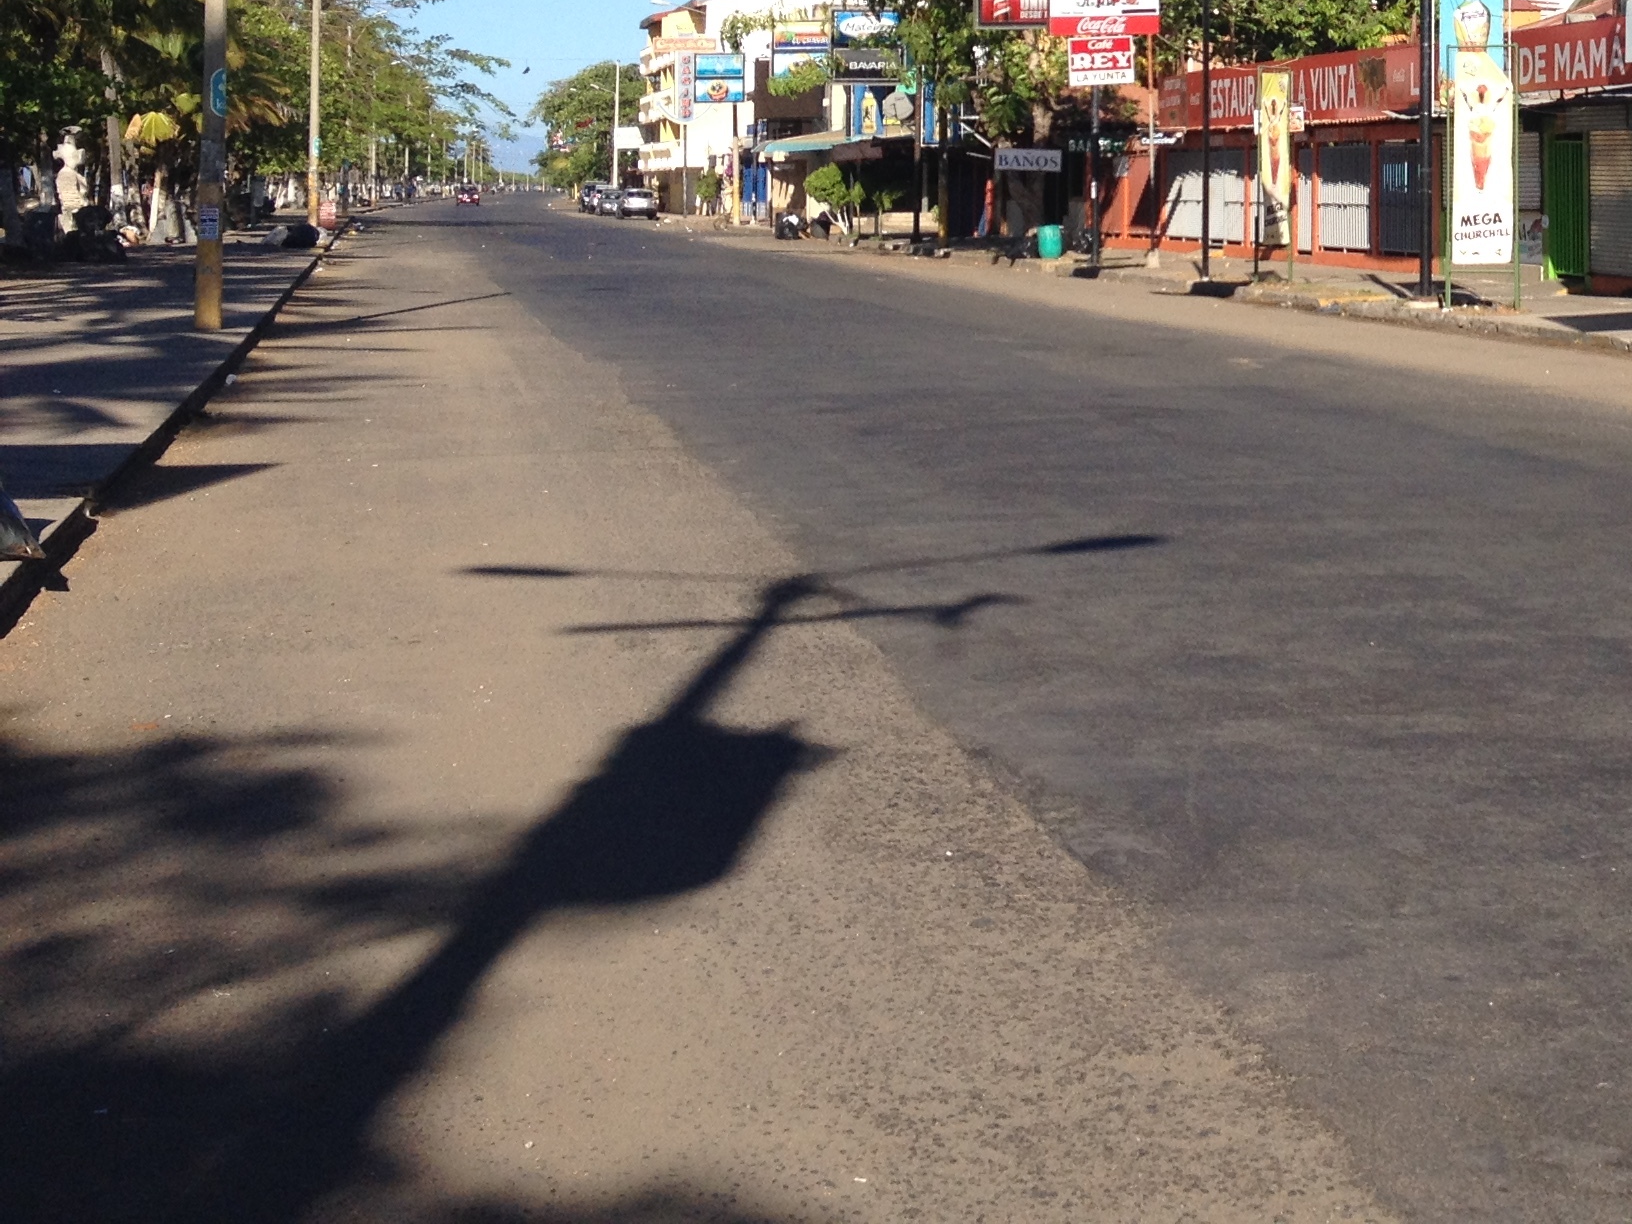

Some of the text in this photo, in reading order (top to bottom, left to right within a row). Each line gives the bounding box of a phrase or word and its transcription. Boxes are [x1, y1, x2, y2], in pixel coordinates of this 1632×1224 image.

[1087, 39, 1114, 50] Café
[1071, 51, 1131, 70] REY
[1519, 22, 1626, 86] DE MAMÁ
[849, 60, 897, 70] BAVARIA
[1076, 71, 1127, 82] LA YUNTA
[1310, 63, 1357, 110] YUNTA
[997, 151, 1060, 170] BAÑOS
[1460, 212, 1503, 228] MEGA
[1454, 228, 1511, 242] CHURCHILL
